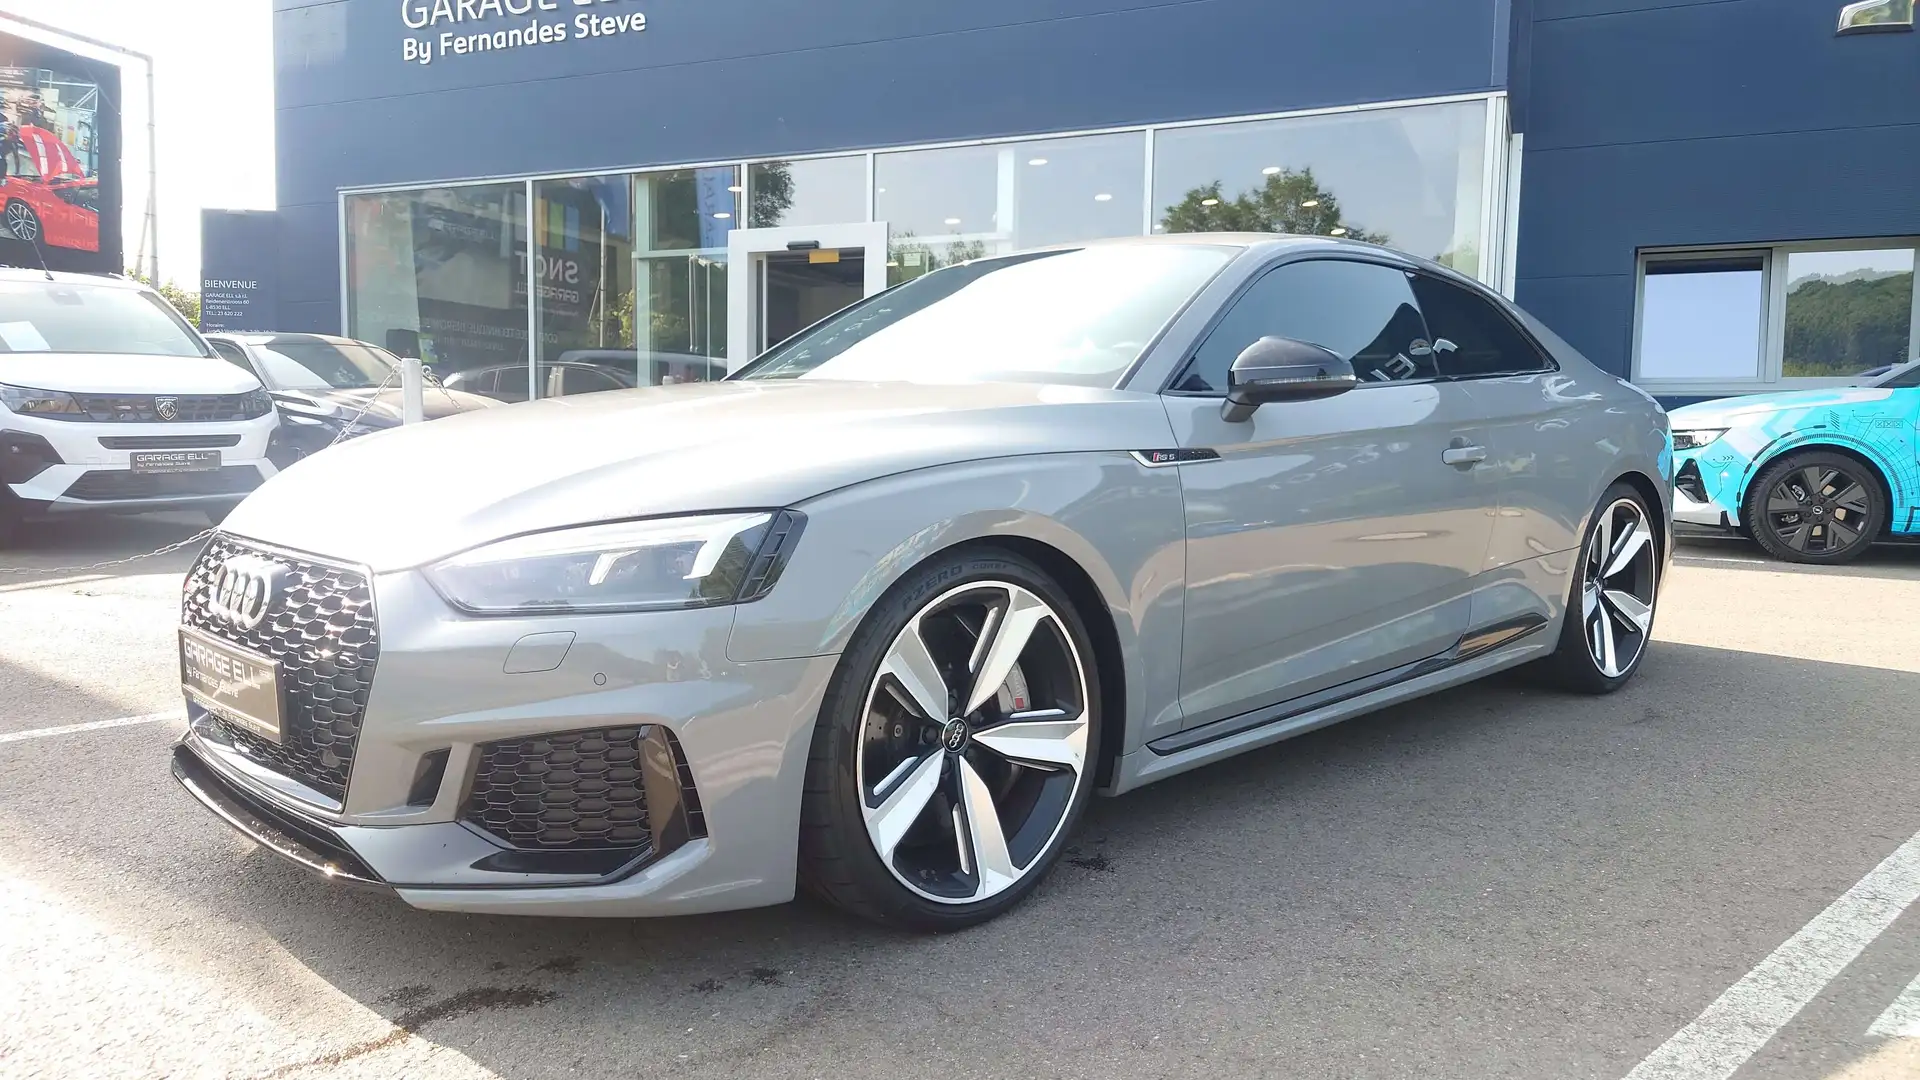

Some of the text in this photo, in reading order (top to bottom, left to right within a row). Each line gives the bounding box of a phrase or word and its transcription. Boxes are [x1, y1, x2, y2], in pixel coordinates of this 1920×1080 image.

[403, 12, 647, 64] By Fernandes Steve
[204, 279, 258, 290] BIENVENUE
[136, 453, 185, 462] GARAGE
[184, 637, 261, 690] GARAGE ELL
